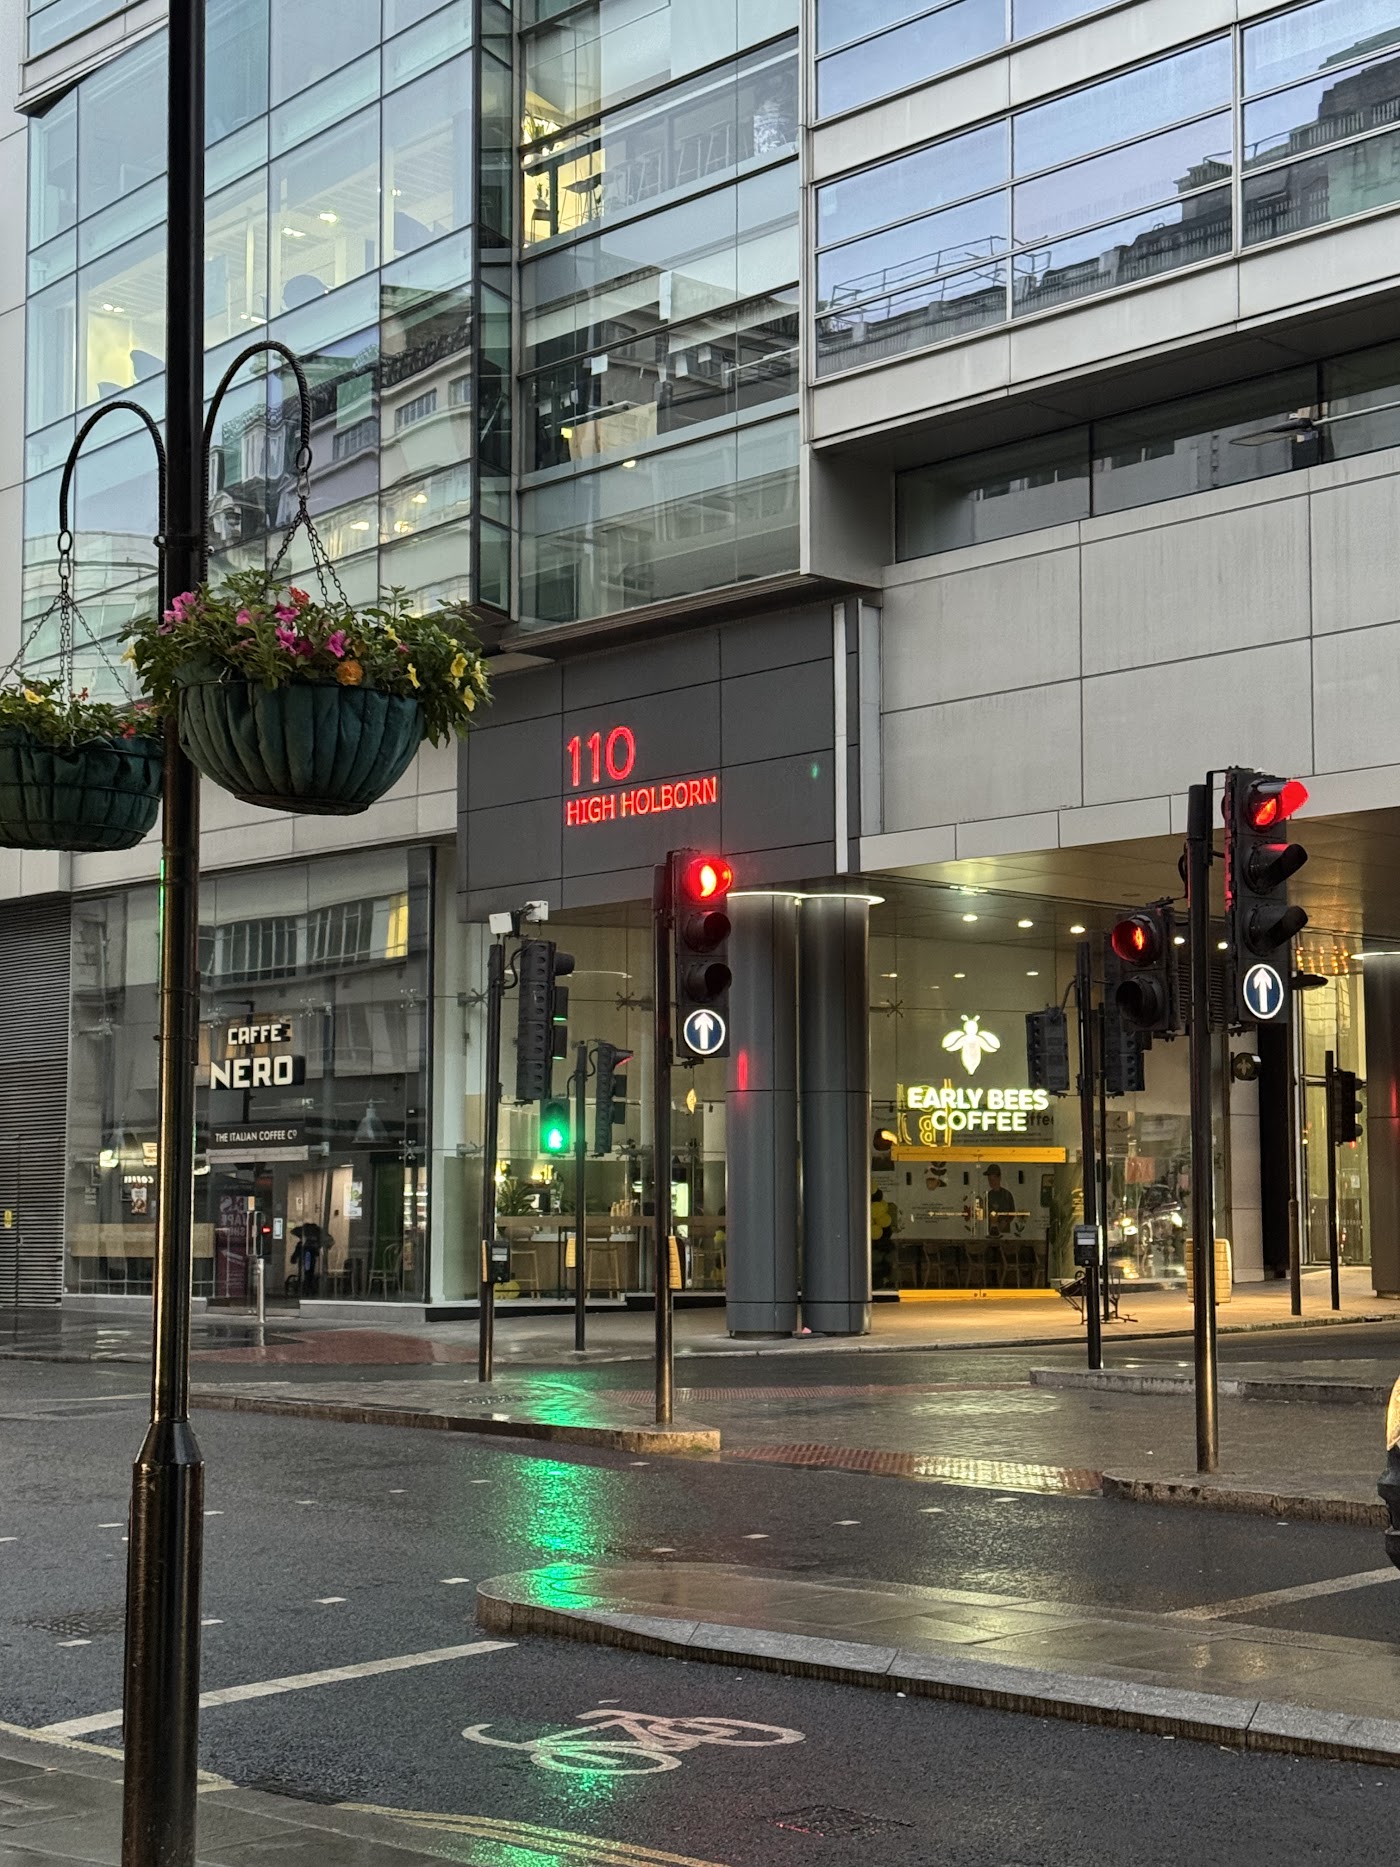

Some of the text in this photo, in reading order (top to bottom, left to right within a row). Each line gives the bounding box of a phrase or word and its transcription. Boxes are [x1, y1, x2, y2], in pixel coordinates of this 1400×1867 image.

[567, 725, 636, 787] 110
[566, 776, 717, 826] HIGH HOLBORN
[210, 1055, 293, 1090] NERO
[907, 1086, 1049, 1111] EARLY BEES
[931, 1110, 1028, 1132] COFFEE
[215, 1132, 228, 1143] THE
[229, 1131, 258, 1142] ITALIAN
[258, 1130, 286, 1141] COFFEE
